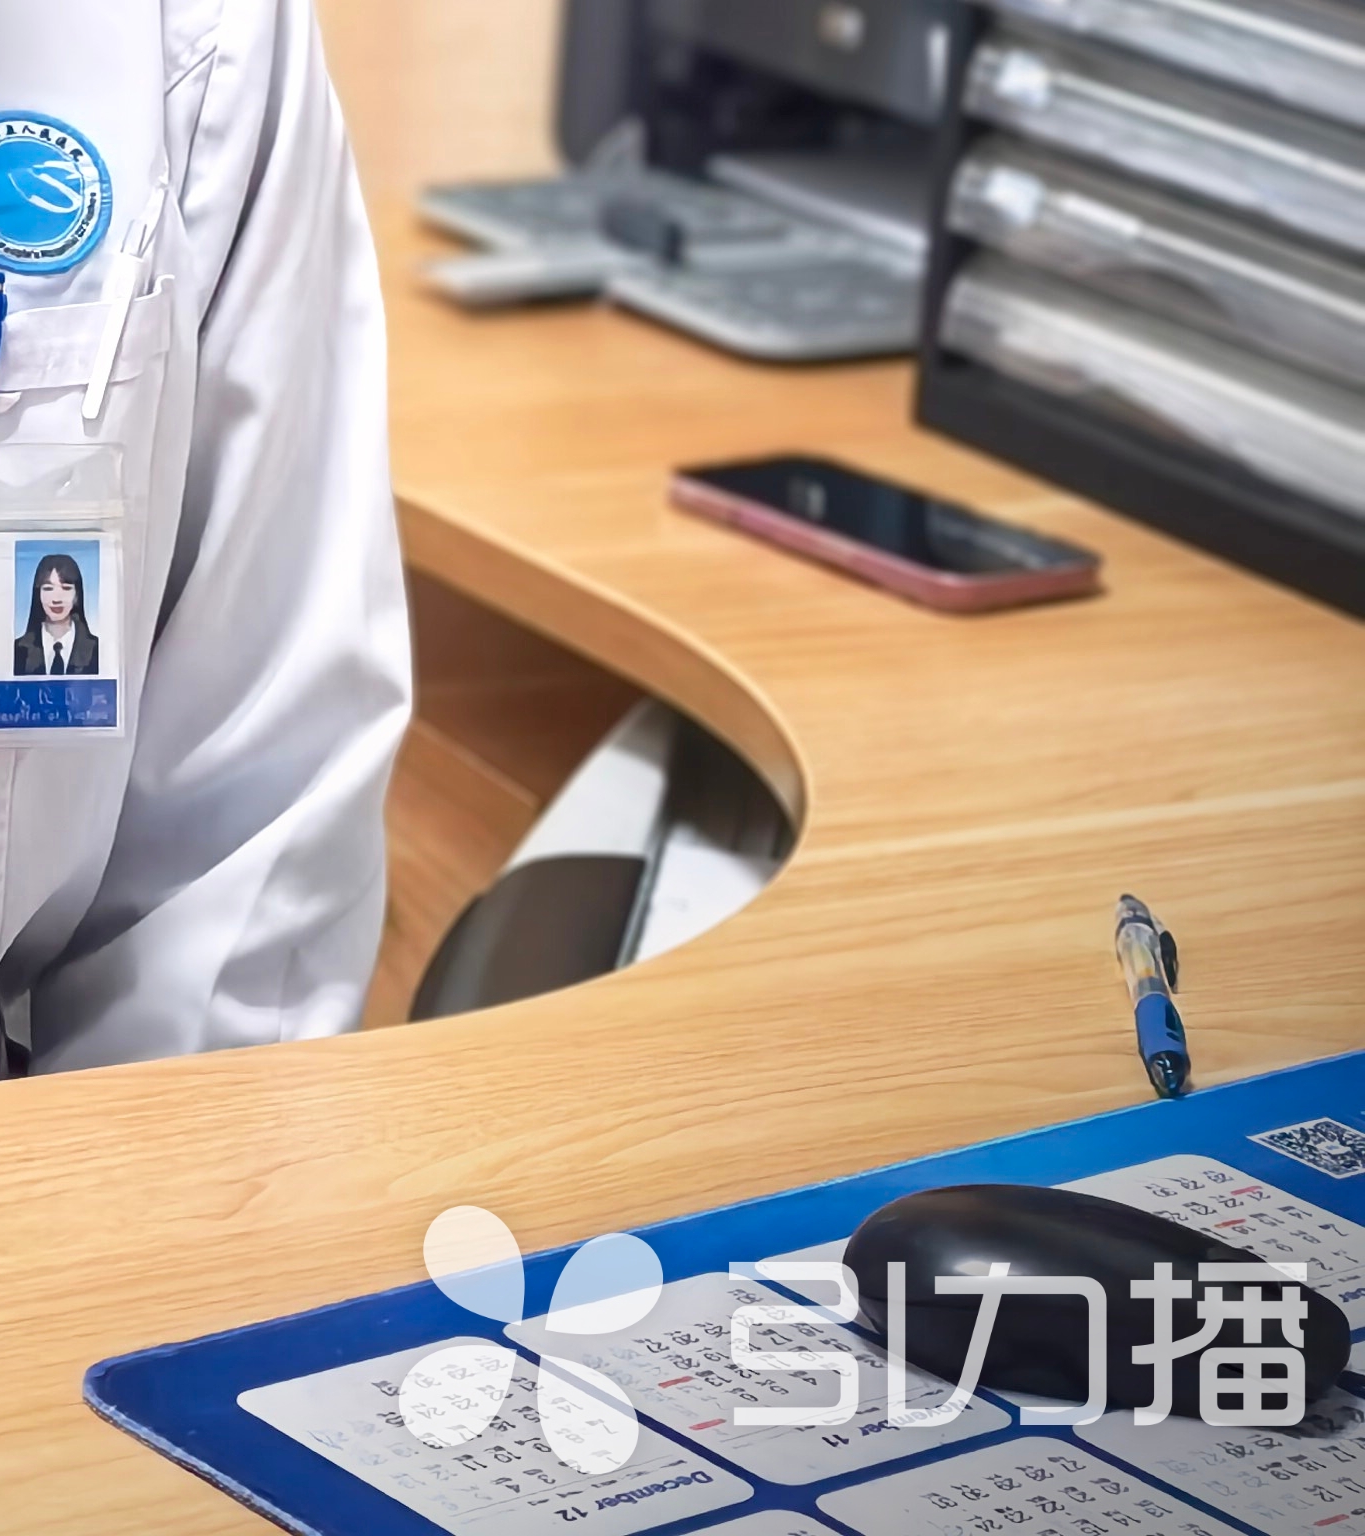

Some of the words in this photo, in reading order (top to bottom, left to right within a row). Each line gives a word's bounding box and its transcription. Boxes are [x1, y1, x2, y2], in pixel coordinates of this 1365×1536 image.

[802, 1377, 817, 1386] 4
[857, 1400, 973, 1436] November
[822, 1434, 849, 1448] 11
[462, 1461, 487, 1471] 11
[505, 1484, 520, 1493] 4
[595, 1471, 713, 1510] December
[554, 1507, 588, 1521] 12
